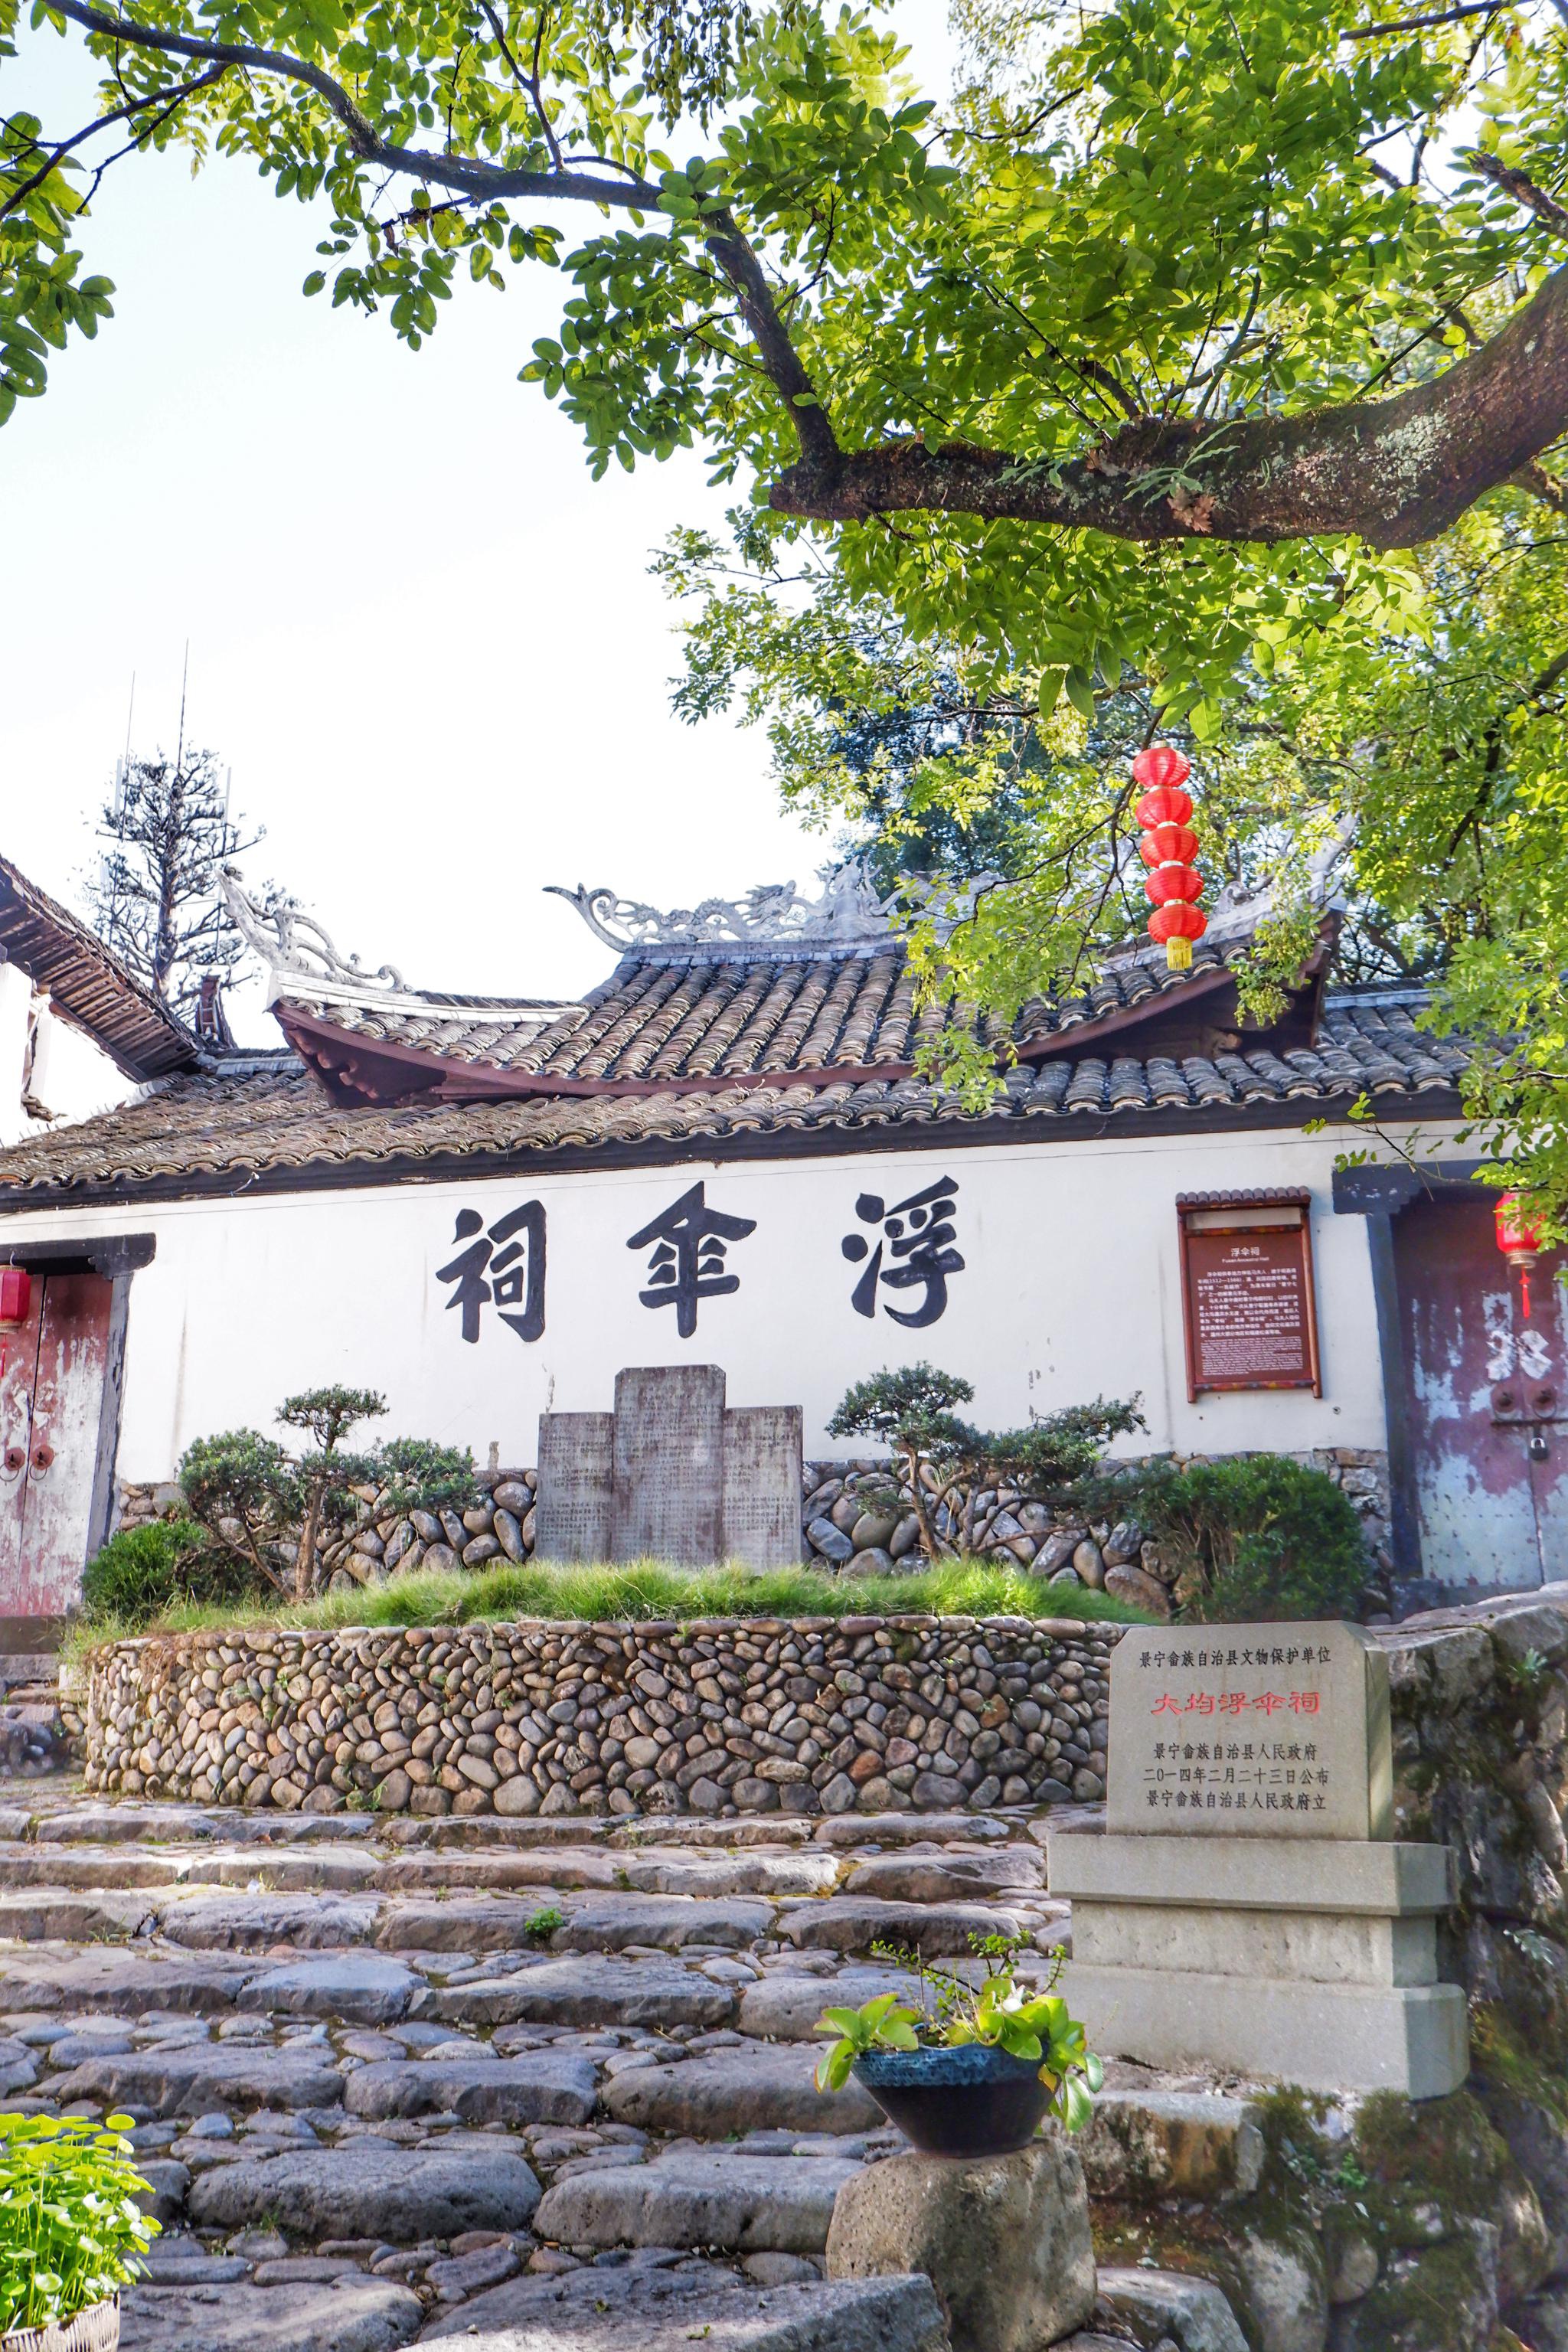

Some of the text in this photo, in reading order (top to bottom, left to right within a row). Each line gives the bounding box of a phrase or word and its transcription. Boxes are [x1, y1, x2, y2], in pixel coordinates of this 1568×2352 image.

[1139, 1646, 1331, 1668] 景宁畲族自治县文物保护单位
[1150, 1690, 1321, 1716] 大均浮伞祠
[1153, 1743, 1318, 1761] 景宁畲族自治县人民政府
[1146, 1789, 1327, 1811] 景宁畲族自治县人民政府立
